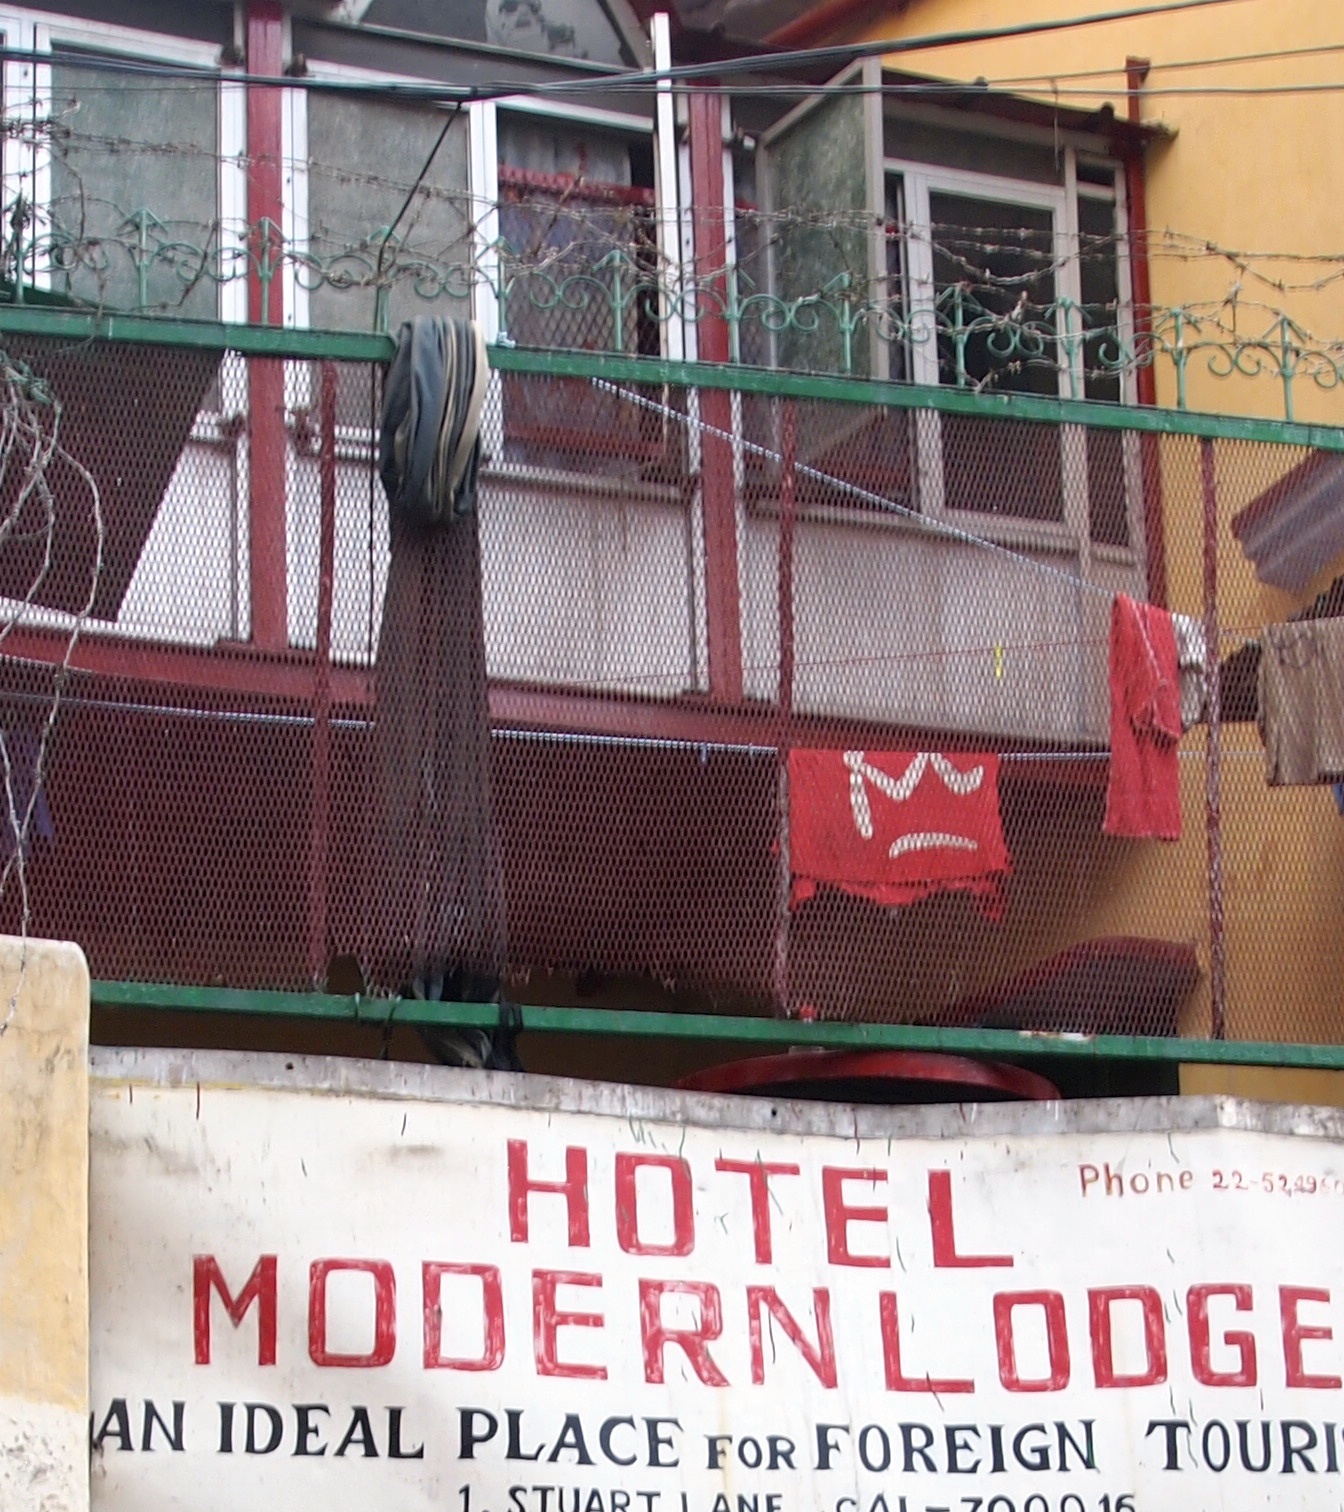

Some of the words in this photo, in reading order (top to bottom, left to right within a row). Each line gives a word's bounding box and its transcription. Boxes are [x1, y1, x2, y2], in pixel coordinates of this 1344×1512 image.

[506, 1139, 1014, 1270] HOTEL
[1078, 1162, 1195, 1198] Phone
[192, 1253, 839, 1390] MODERN
[878, 1283, 1344, 1394] LODGE
[91, 1398, 185, 1453] AN
[217, 1402, 426, 1460] IDEAL
[456, 1406, 683, 1468] PLACE
[706, 1434, 797, 1472] FOR
[814, 1419, 1099, 1475] FOREIGN
